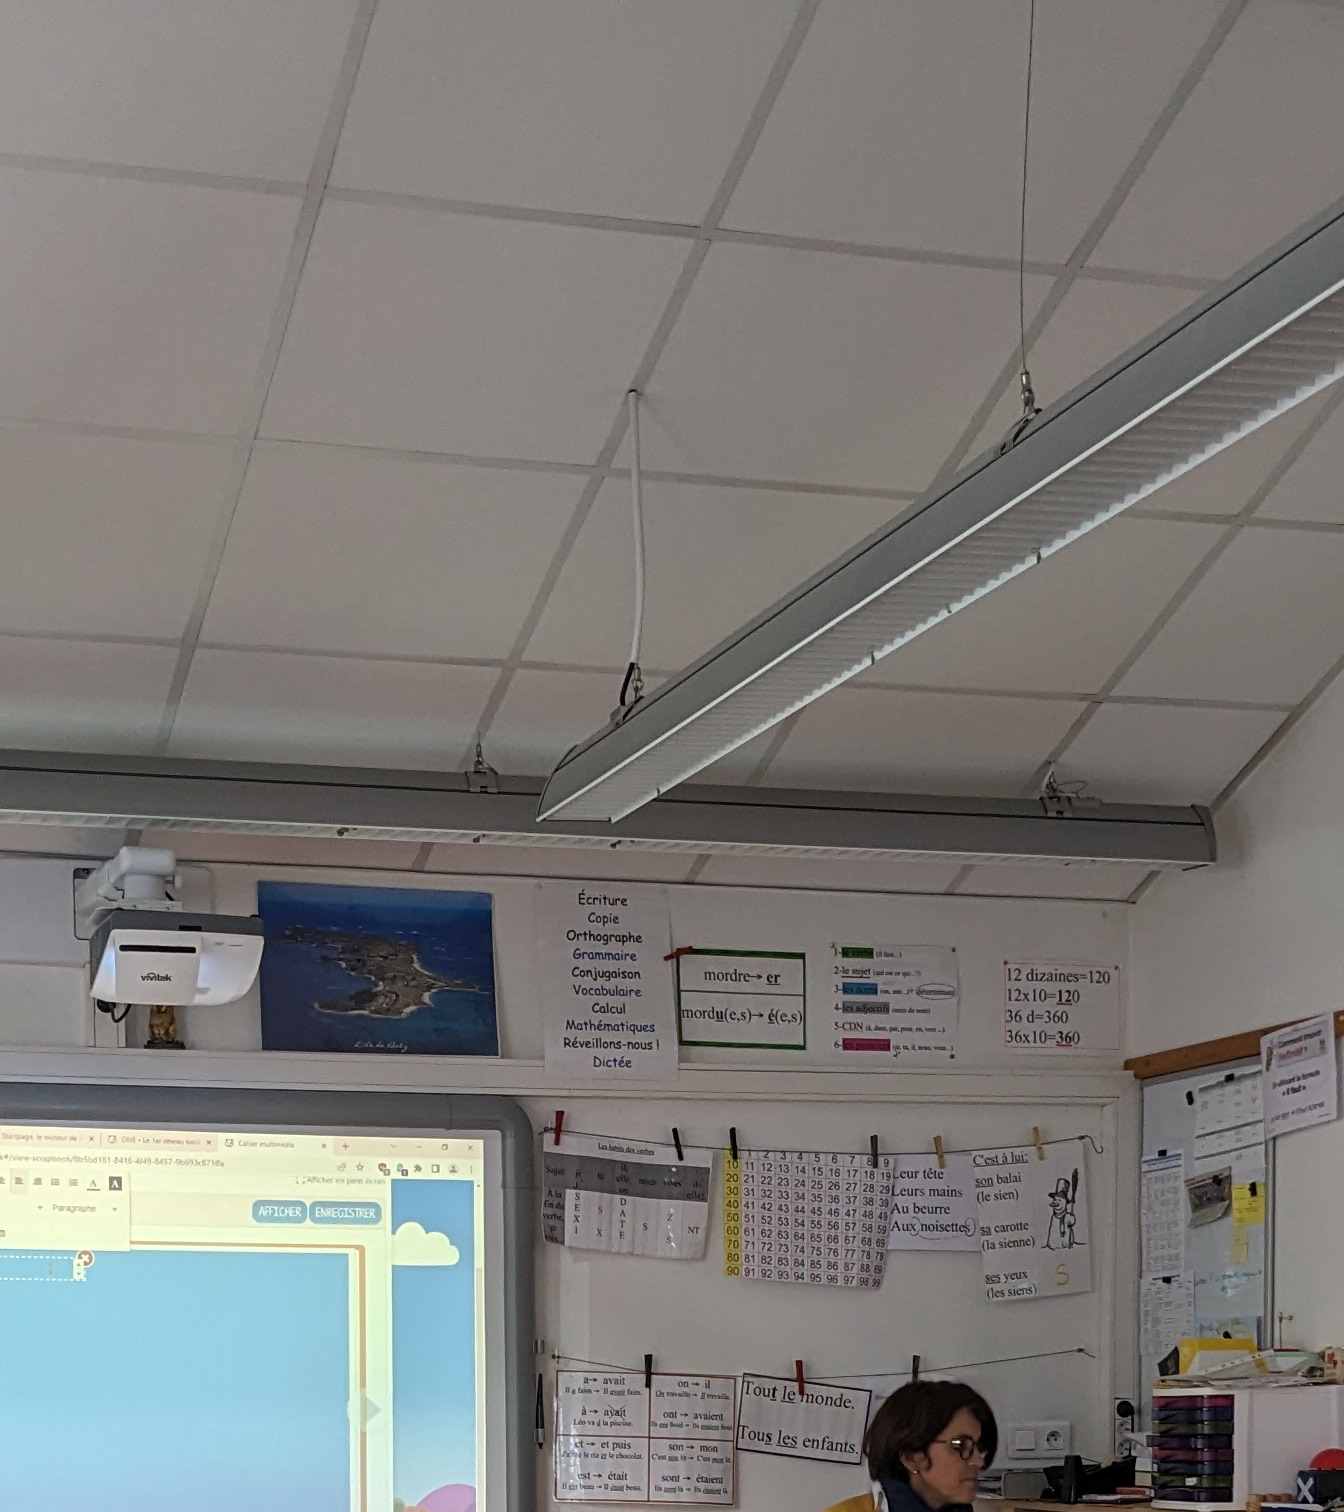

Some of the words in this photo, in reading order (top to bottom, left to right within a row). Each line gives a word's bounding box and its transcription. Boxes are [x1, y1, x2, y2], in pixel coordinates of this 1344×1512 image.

[578, 890, 628, 907] Écriture
[587, 912, 620, 926] Copie
[566, 930, 643, 946] Orthographe
[572, 949, 638, 965] Grammaire
[140, 972, 172, 983] vivitek
[571, 966, 641, 980] Conjugaison
[704, 968, 751, 982] mordre
[766, 972, 780, 986] er
[1006, 968, 1022, 982] 12
[1026, 968, 1111, 984] dizaines=120
[572, 984, 642, 998] Vocabulaire
[1006, 989, 1080, 1003] 12x10=120
[591, 1002, 626, 1015] Calcul
[1006, 1009, 1022, 1024] 36
[1026, 1009, 1069, 1024] d=360
[565, 1020, 656, 1036] Mathématiques
[563, 1036, 653, 1051] Réveillons-nous
[1006, 1030, 1080, 1045] 36x10=360
[592, 1055, 632, 1069] Dictée
[973, 1153, 1000, 1166] C'est
[1002, 1154, 1009, 1164] à
[1012, 1152, 1029, 1163] lui:
[923, 1167, 944, 1179] tête
[975, 1177, 994, 1187] son
[996, 1172, 1022, 1184] balai
[891, 1185, 925, 1197] Leurs
[928, 1185, 963, 1197] mains
[976, 1192, 991, 1204] (le
[993, 1189, 1019, 1202] sien)
[258, 1206, 302, 1217] AFFICHER
[315, 1207, 376, 1219] ENREGISTRER
[890, 1202, 909, 1215] Au
[912, 1202, 950, 1215] beurre
[890, 1220, 917, 1232] Aux
[920, 1220, 971, 1233] noisettes
[980, 1226, 992, 1236] sa
[994, 1221, 1029, 1233] carotte
[981, 1239, 996, 1251] (la
[998, 1235, 1035, 1249] sienne)
[986, 1274, 1001, 1284] ses
[1003, 1270, 1028, 1282] yeux
[987, 1288, 1005, 1300] (les
[1008, 1285, 1037, 1297] siens)
[743, 1381, 777, 1401] Tout
[780, 1388, 796, 1403] le
[800, 1392, 855, 1410] monde.
[738, 1424, 772, 1445] Tous
[776, 1429, 797, 1449] les
[802, 1434, 859, 1455] enfants.
